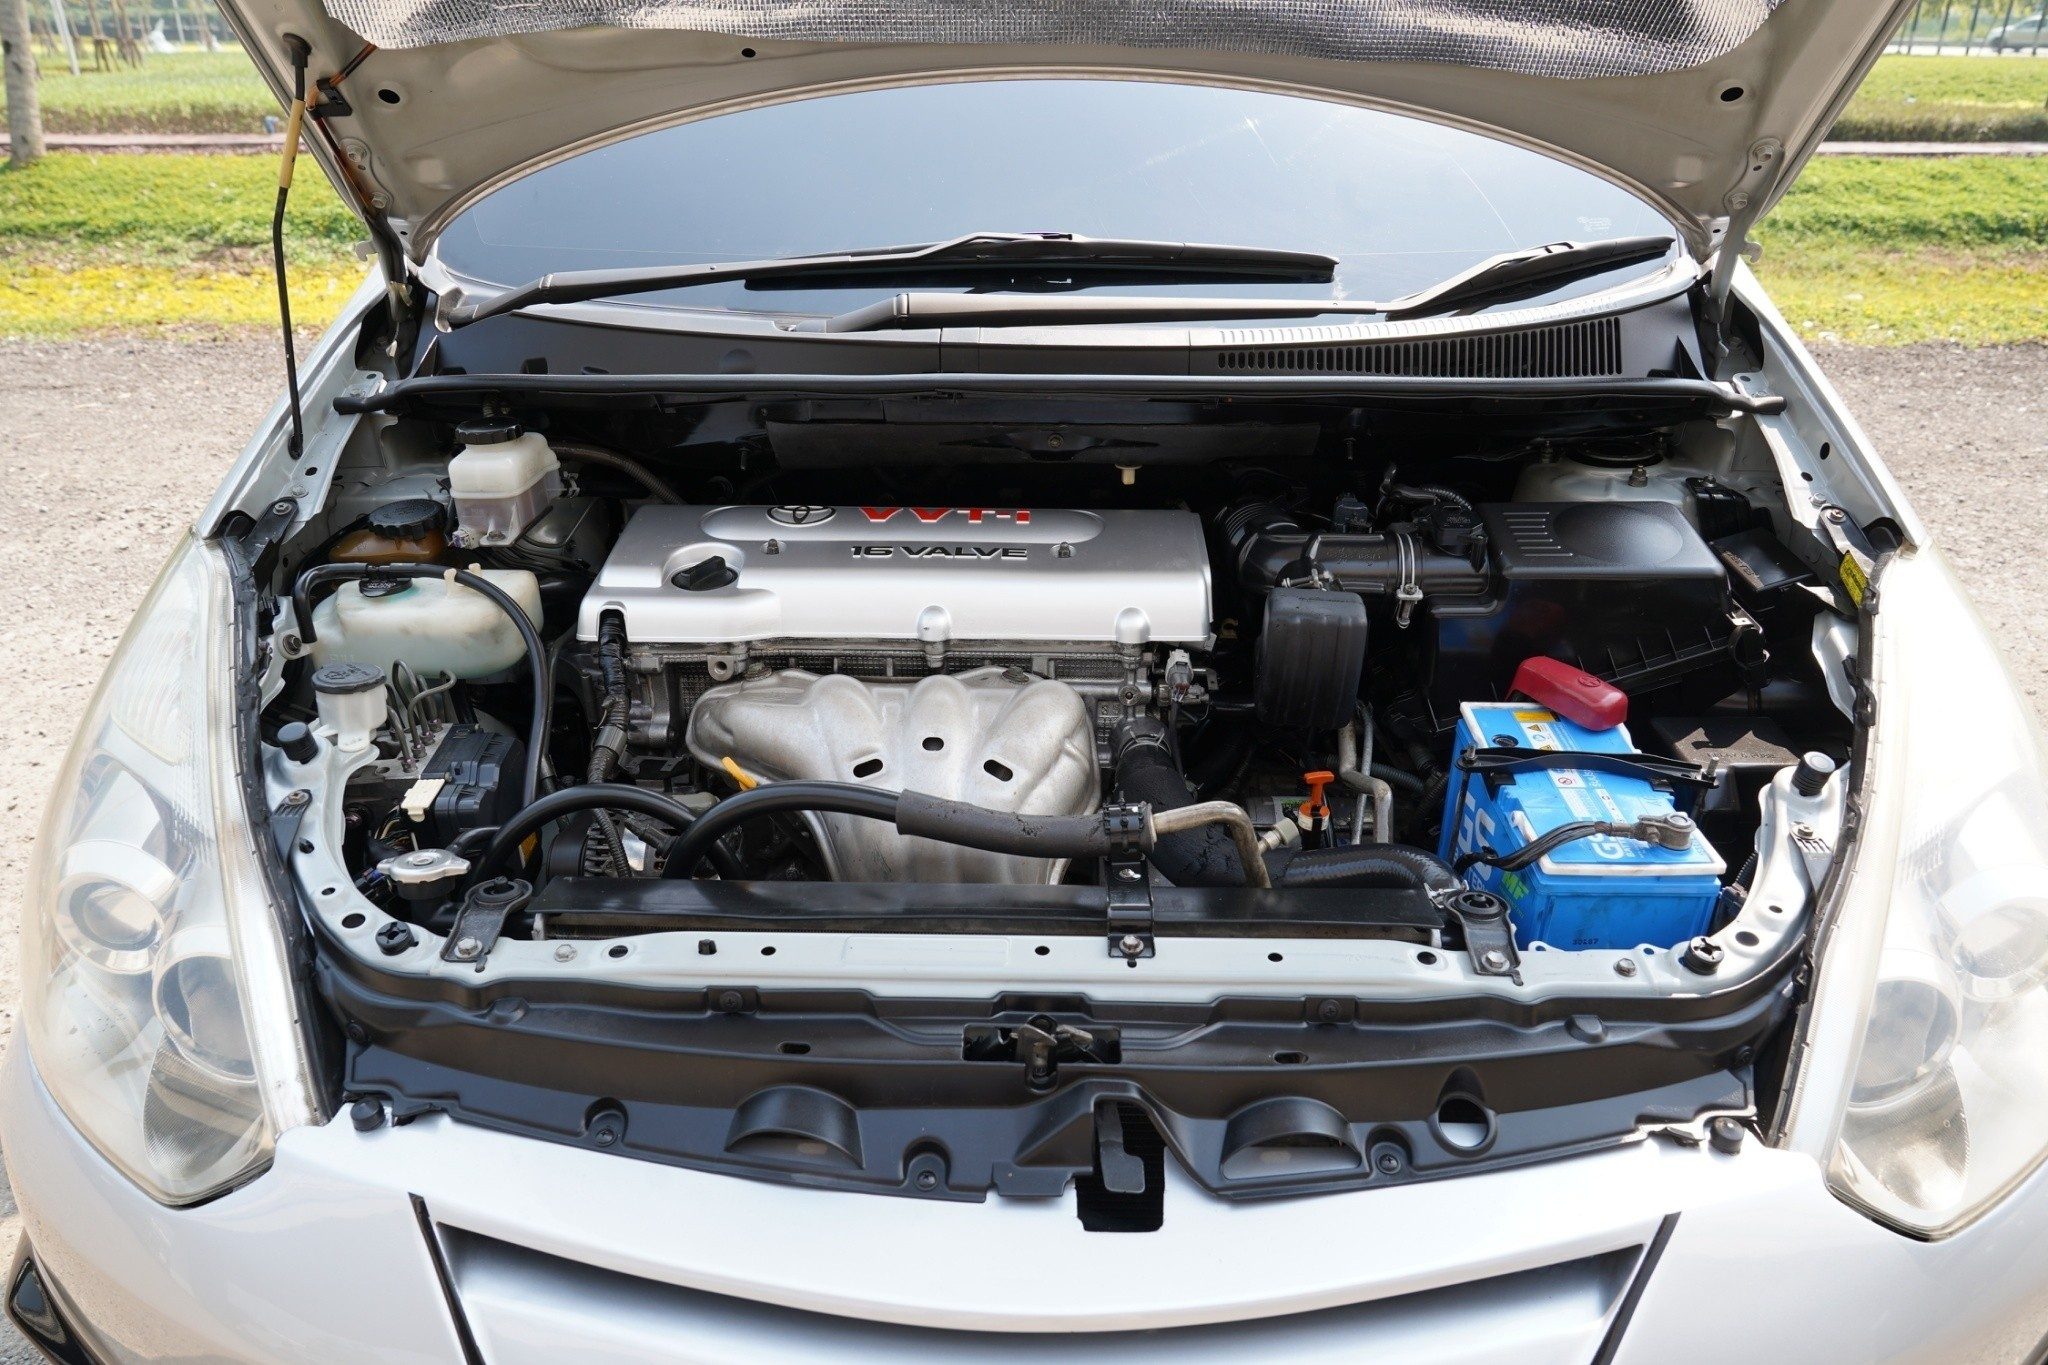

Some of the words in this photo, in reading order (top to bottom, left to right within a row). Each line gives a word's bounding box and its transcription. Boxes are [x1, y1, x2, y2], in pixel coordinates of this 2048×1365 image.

[850, 546, 895, 559] 16
[899, 546, 1029, 560] VALVE
[1501, 870, 1530, 900] MF
